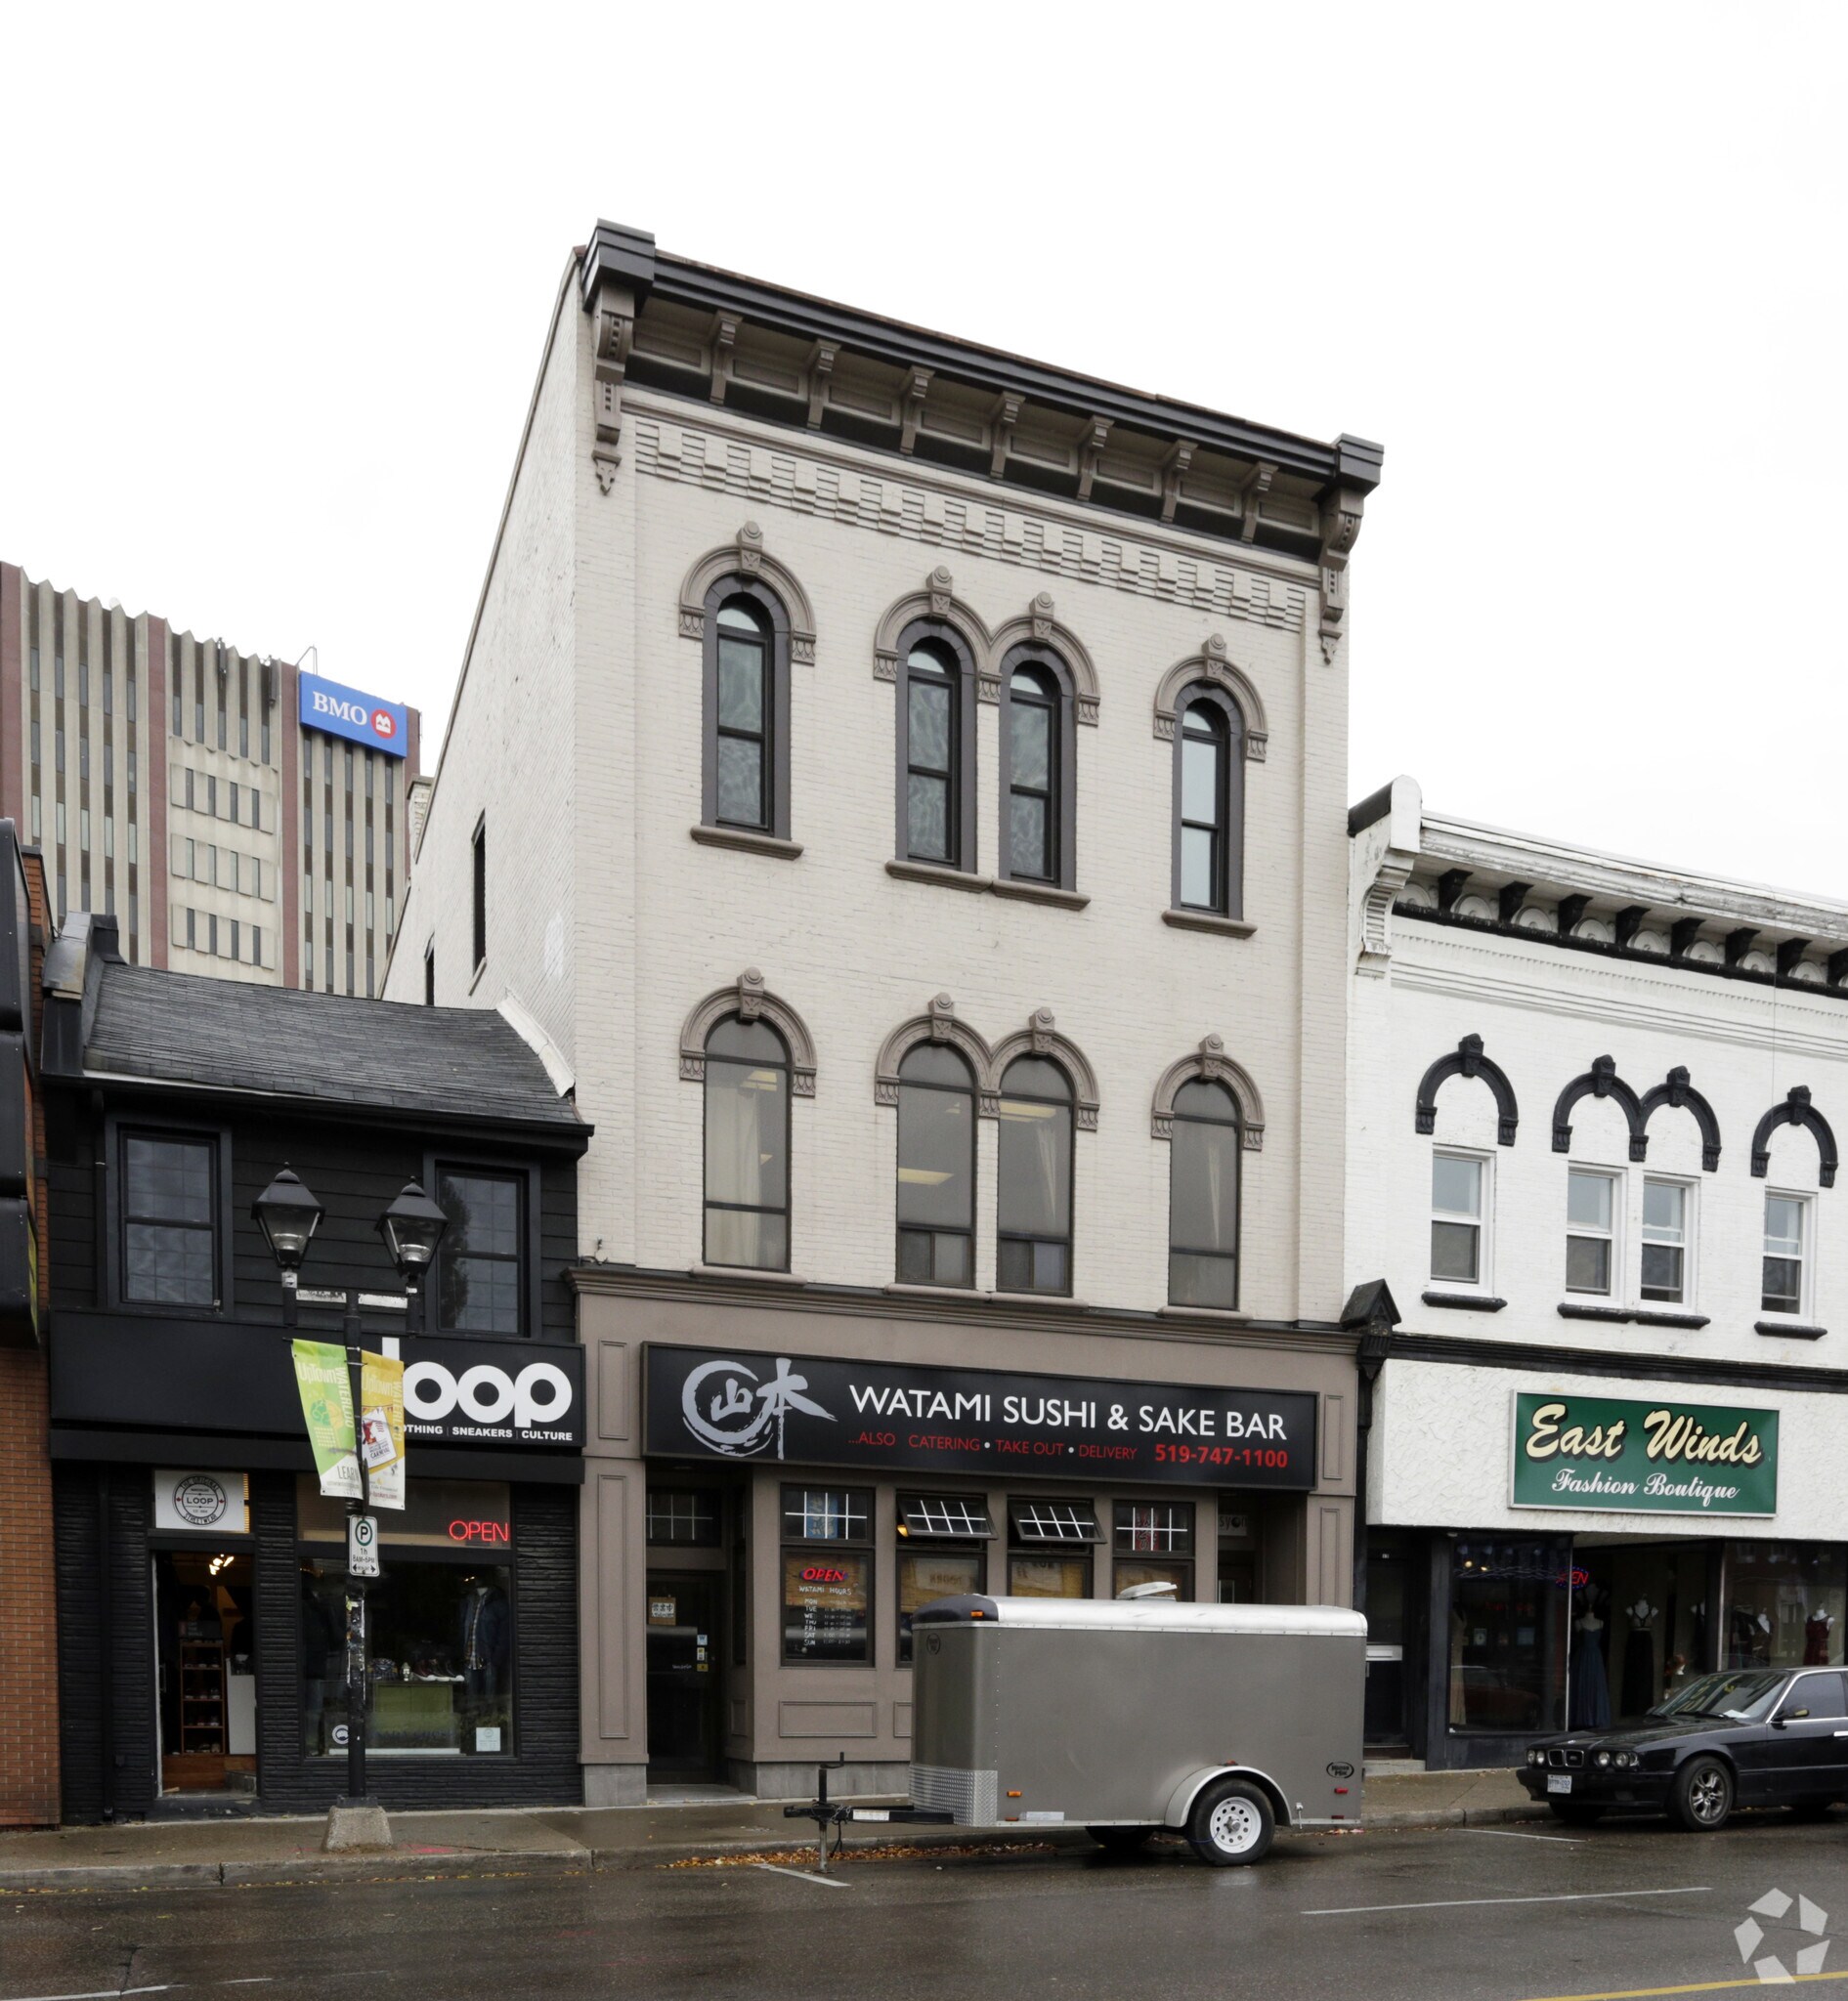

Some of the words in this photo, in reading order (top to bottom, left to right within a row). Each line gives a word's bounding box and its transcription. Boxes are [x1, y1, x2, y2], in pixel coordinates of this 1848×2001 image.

[313, 691, 367, 726] BMO
[336, 1366, 355, 1428] WATERLOO
[382, 1337, 573, 1428] oop
[848, 1384, 991, 1422] WATAMI
[1003, 1395, 1096, 1428] SUSHI
[1106, 1404, 1130, 1431] &
[1139, 1405, 1216, 1436] SAKE
[1225, 1411, 1288, 1441] BAR
[452, 1426, 513, 1438] SNEAKERS
[522, 1430, 574, 1441] CULTURE
[1526, 1403, 1626, 1459] East
[1644, 1410, 1762, 1464] Winds
[908, 1434, 980, 1452] CATERING
[995, 1439, 1030, 1454] TAKE
[1033, 1440, 1065, 1457] OUT
[1078, 1444, 1139, 1461] DELIVERY
[1155, 1443, 1289, 1469] 519-747-1100
[1551, 1468, 1639, 1496] Fashion
[1643, 1472, 1741, 1508] Boutique
[360, 1525, 368, 1541] P
[449, 1519, 510, 1542] OPEN
[798, 1585, 826, 1594] WATAMI
[829, 1586, 852, 1596] HOURS
[802, 1567, 846, 1582] OPEN
